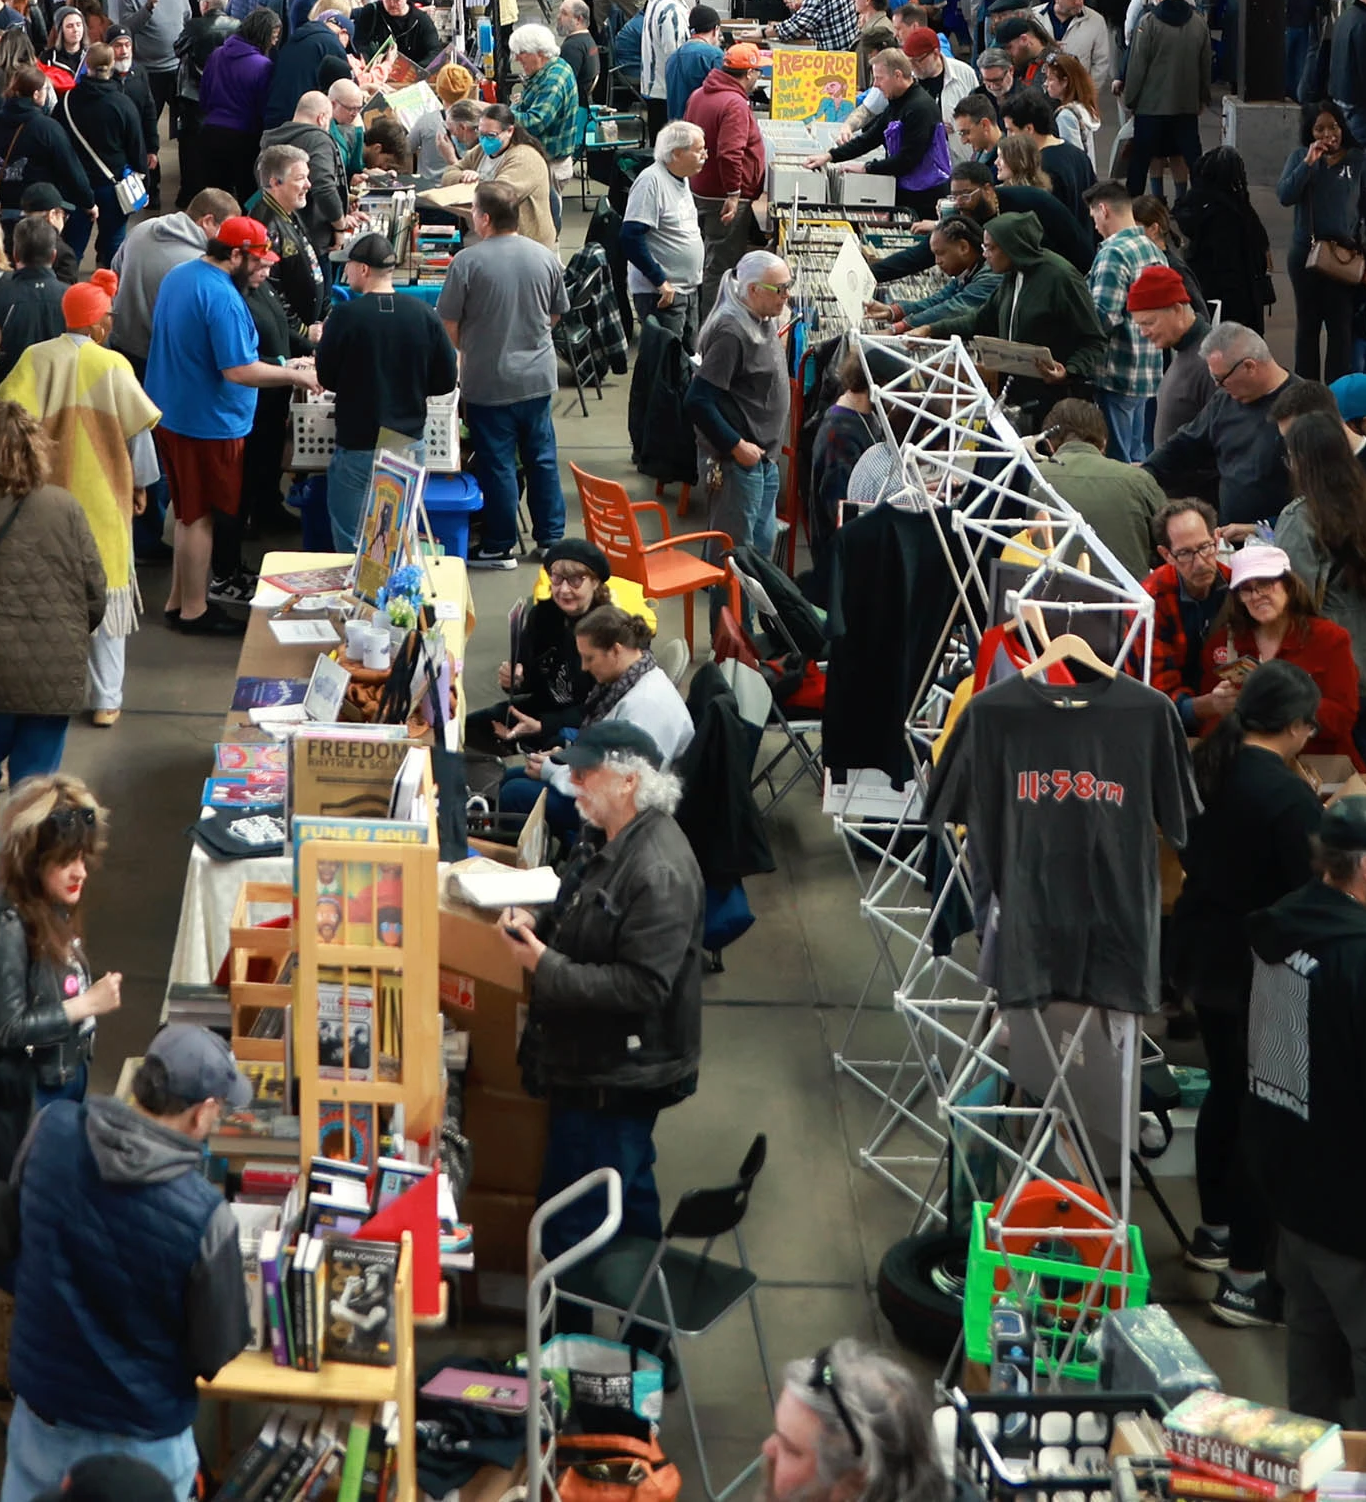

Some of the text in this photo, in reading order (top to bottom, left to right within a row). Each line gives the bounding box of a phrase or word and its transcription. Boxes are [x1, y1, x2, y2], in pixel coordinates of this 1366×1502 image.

[778, 53, 855, 76] RECORDS
[778, 77, 801, 90] BUY
[307, 739, 410, 760] FREEDOM
[333, 1249, 397, 1264] BRIAN JOHNSON
[1162, 1430, 1250, 1473] STEPHEN
[1253, 1458, 1301, 1487] KING
